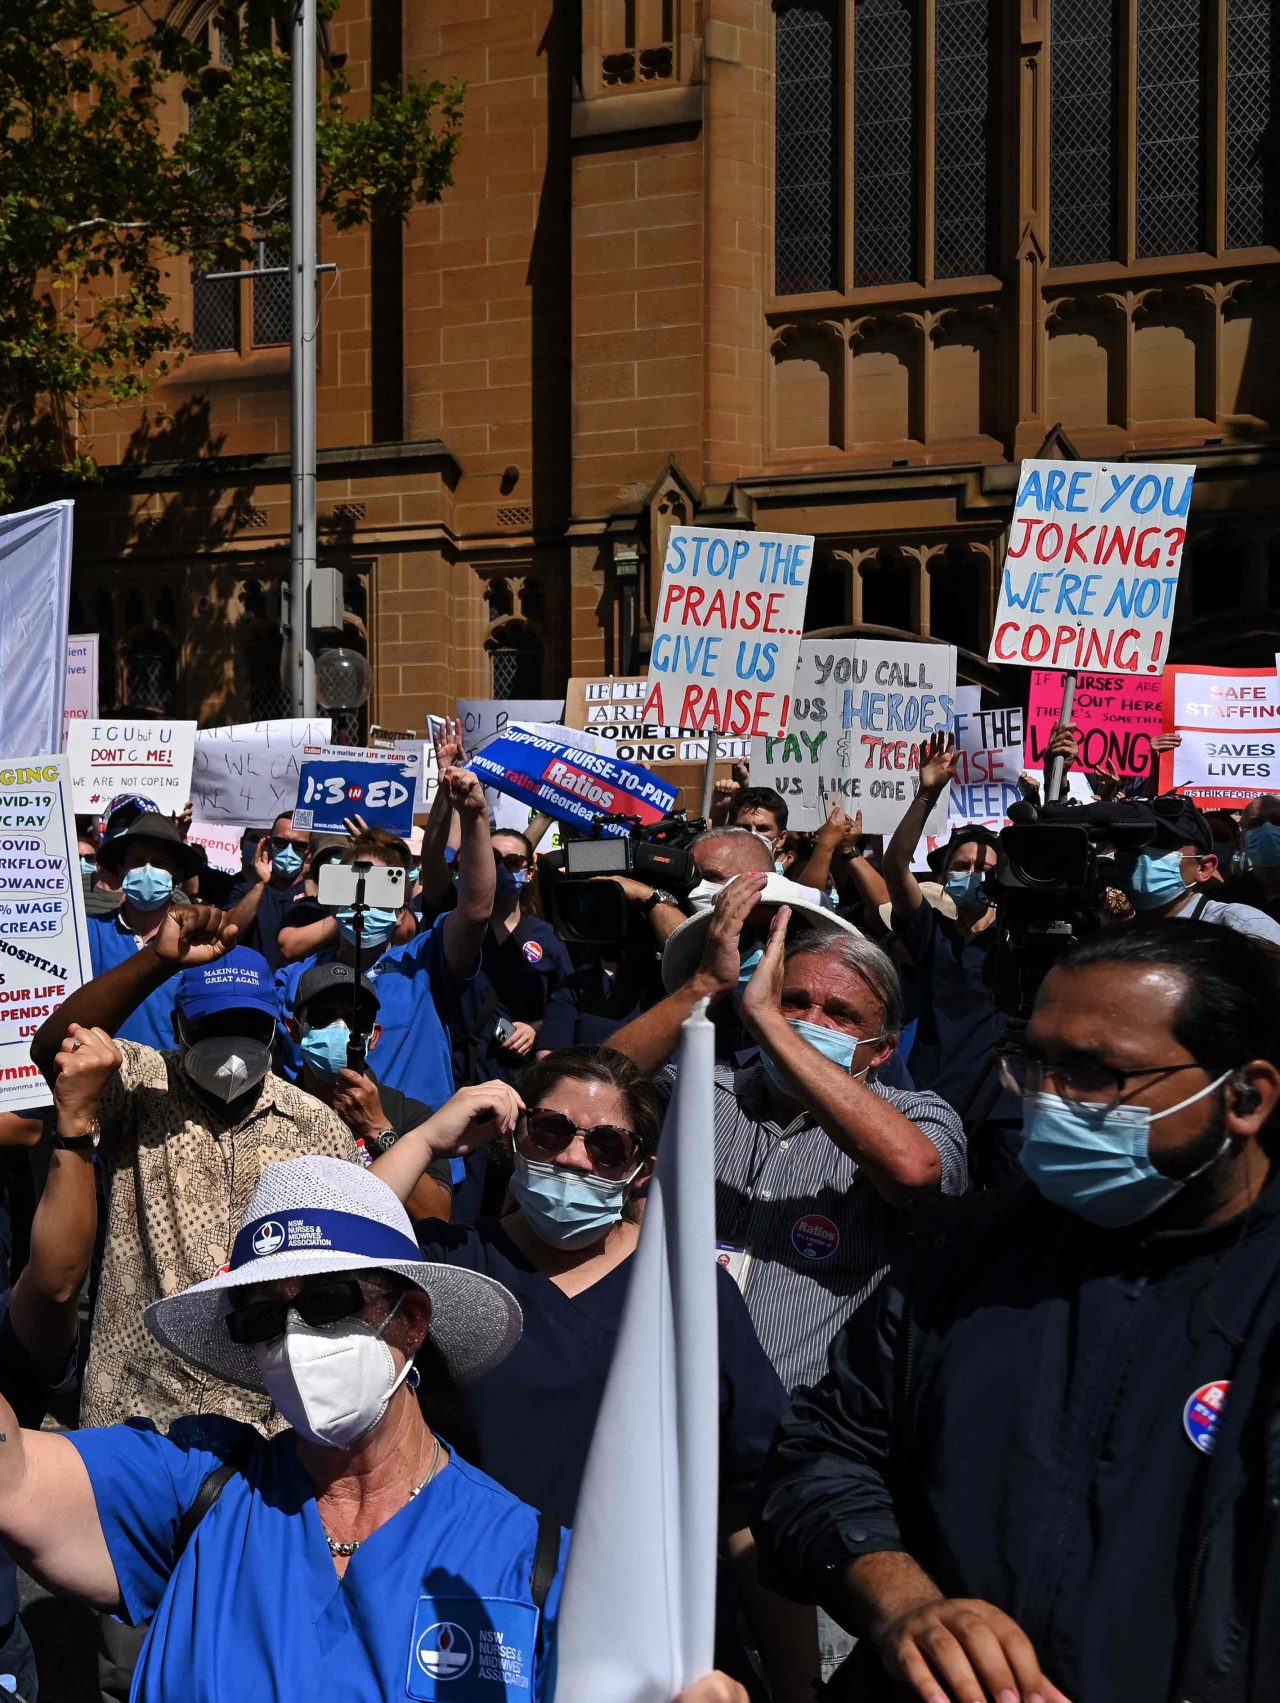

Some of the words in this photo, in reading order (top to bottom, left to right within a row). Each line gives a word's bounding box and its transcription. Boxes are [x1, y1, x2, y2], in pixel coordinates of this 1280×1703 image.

[1016, 470, 1092, 512] ARE
[1100, 474, 1195, 518] YOU
[1007, 518, 1187, 568] JOKING?
[666, 536, 750, 580] STOP
[759, 541, 811, 586] THE
[1004, 568, 1102, 615] WE'RE
[1104, 577, 1179, 619] NOT
[994, 622, 1163, 672] COPING!
[652, 634, 723, 677] GIVE
[735, 640, 779, 683] US
[815, 655, 868, 685] YOU
[874, 660, 934, 690] CALL
[589, 685, 609, 699] IF
[1035, 673, 1051, 686] IF
[1136, 682, 1160, 692] ARE
[1210, 686, 1266, 699] SAFE
[641, 682, 664, 726] A
[680, 684, 790, 738] RAISE!
[793, 697, 828, 722] US
[842, 689, 954, 733] HEROES
[137, 729, 152, 742] but
[160, 729, 171, 743] U
[973, 709, 1021, 749] THE
[500, 727, 565, 755] SUPPORT
[1206, 743, 1275, 757] SAVES
[91, 749, 125, 761] DONT
[146, 750, 172, 763] ME!
[1208, 763, 1271, 777] LIVES
[73, 777, 85, 786] WE
[93, 777, 113, 786] ARE
[121, 777, 137, 786] NOT
[141, 777, 179, 786] COPING
[548, 762, 615, 809] Ratios
[776, 777, 803, 795] US
[304, 775, 346, 805] 1:3
[348, 788, 362, 798] IN
[365, 780, 408, 808] ED
[16, 815, 46, 828] PAY
[16, 902, 62, 915] WAGE
[204, 967, 238, 977] MAKING
[205, 976, 233, 985] GREAT
[34, 985, 65, 998] LIFE
[799, 1221, 836, 1241] Ratios
[479, 1630, 504, 1644] NSW
[479, 1644, 516, 1658] NURSES
[478, 1668, 529, 1688] ASSOCIATION
